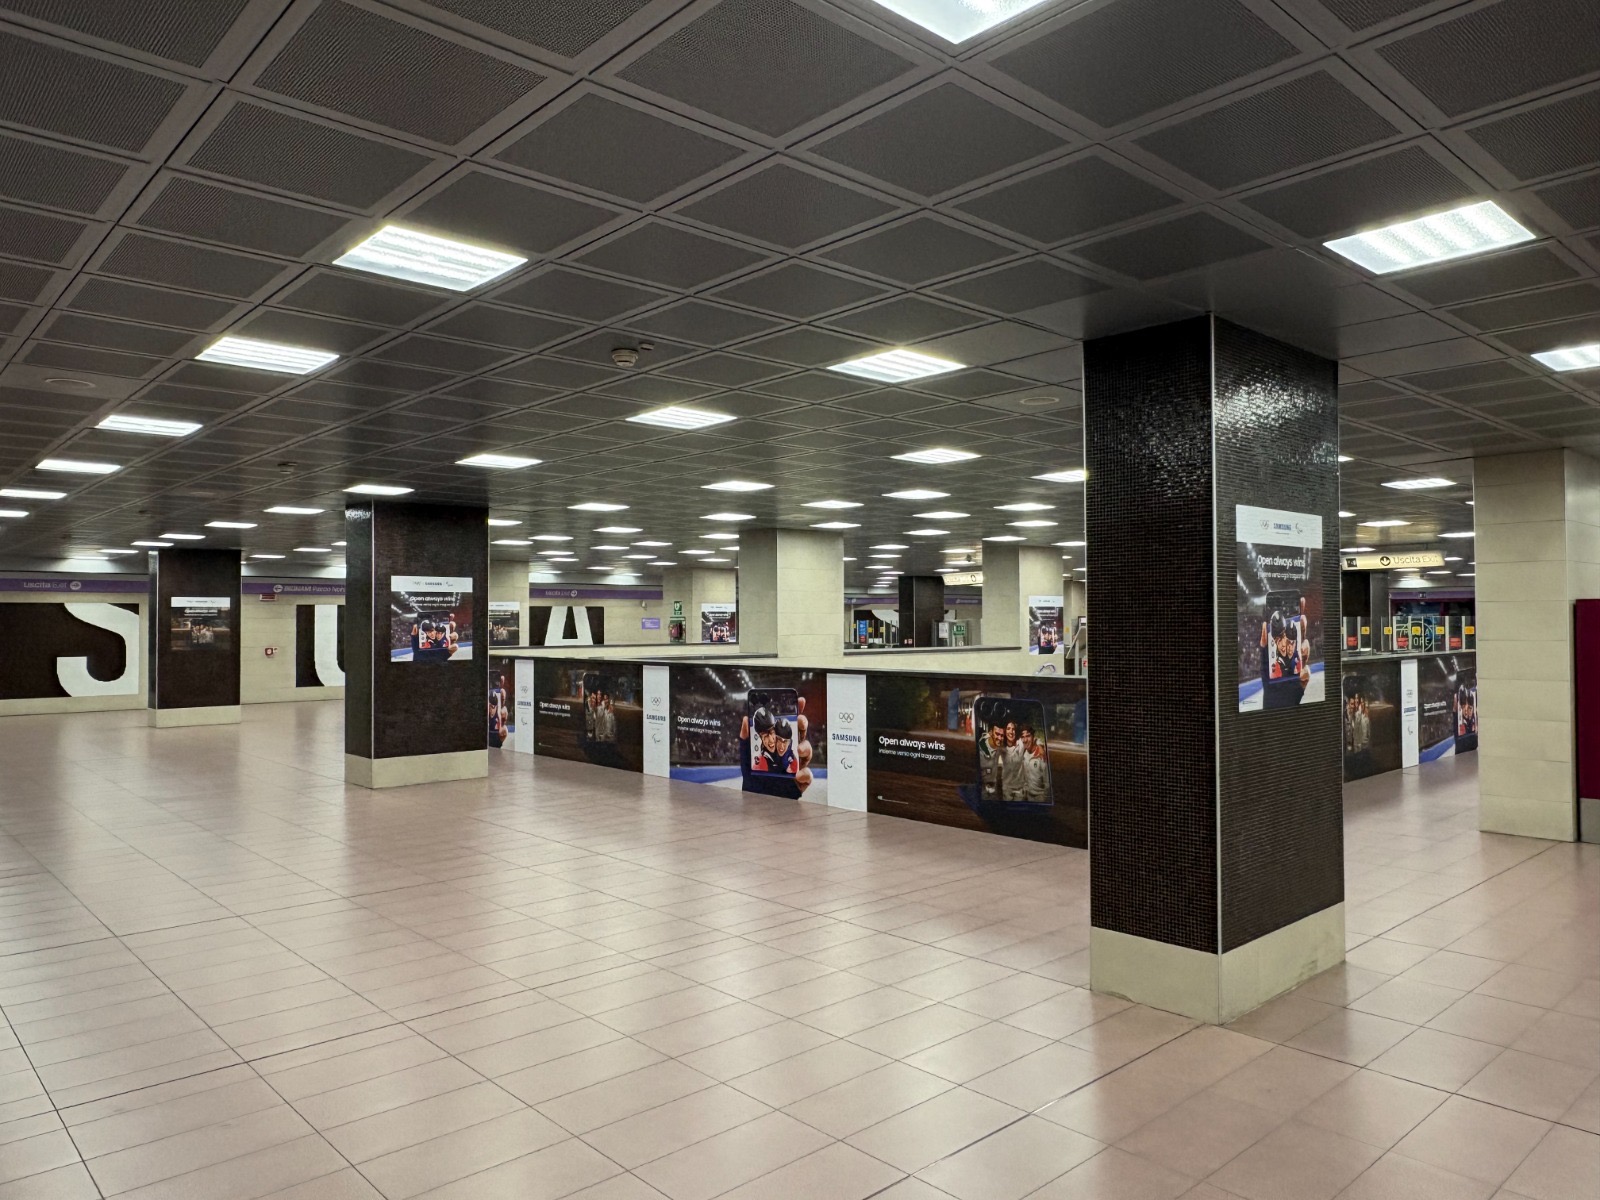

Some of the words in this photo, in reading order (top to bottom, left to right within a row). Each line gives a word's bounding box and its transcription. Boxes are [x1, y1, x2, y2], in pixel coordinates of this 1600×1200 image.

[1257, 555, 1273, 568] Open
[1273, 556, 1293, 570] always
[1293, 556, 1306, 567] wins
[1393, 556, 1421, 565] Uscita
[1422, 555, 1440, 564] Exit
[23, 581, 51, 589] Uscita
[677, 715, 690, 724] Open
[690, 717, 709, 727] always
[709, 718, 721, 727] wins
[832, 732, 861, 743] SAMSUNG
[879, 735, 898, 747] Open
[899, 738, 926, 751] always
[927, 740, 946, 751] wins
